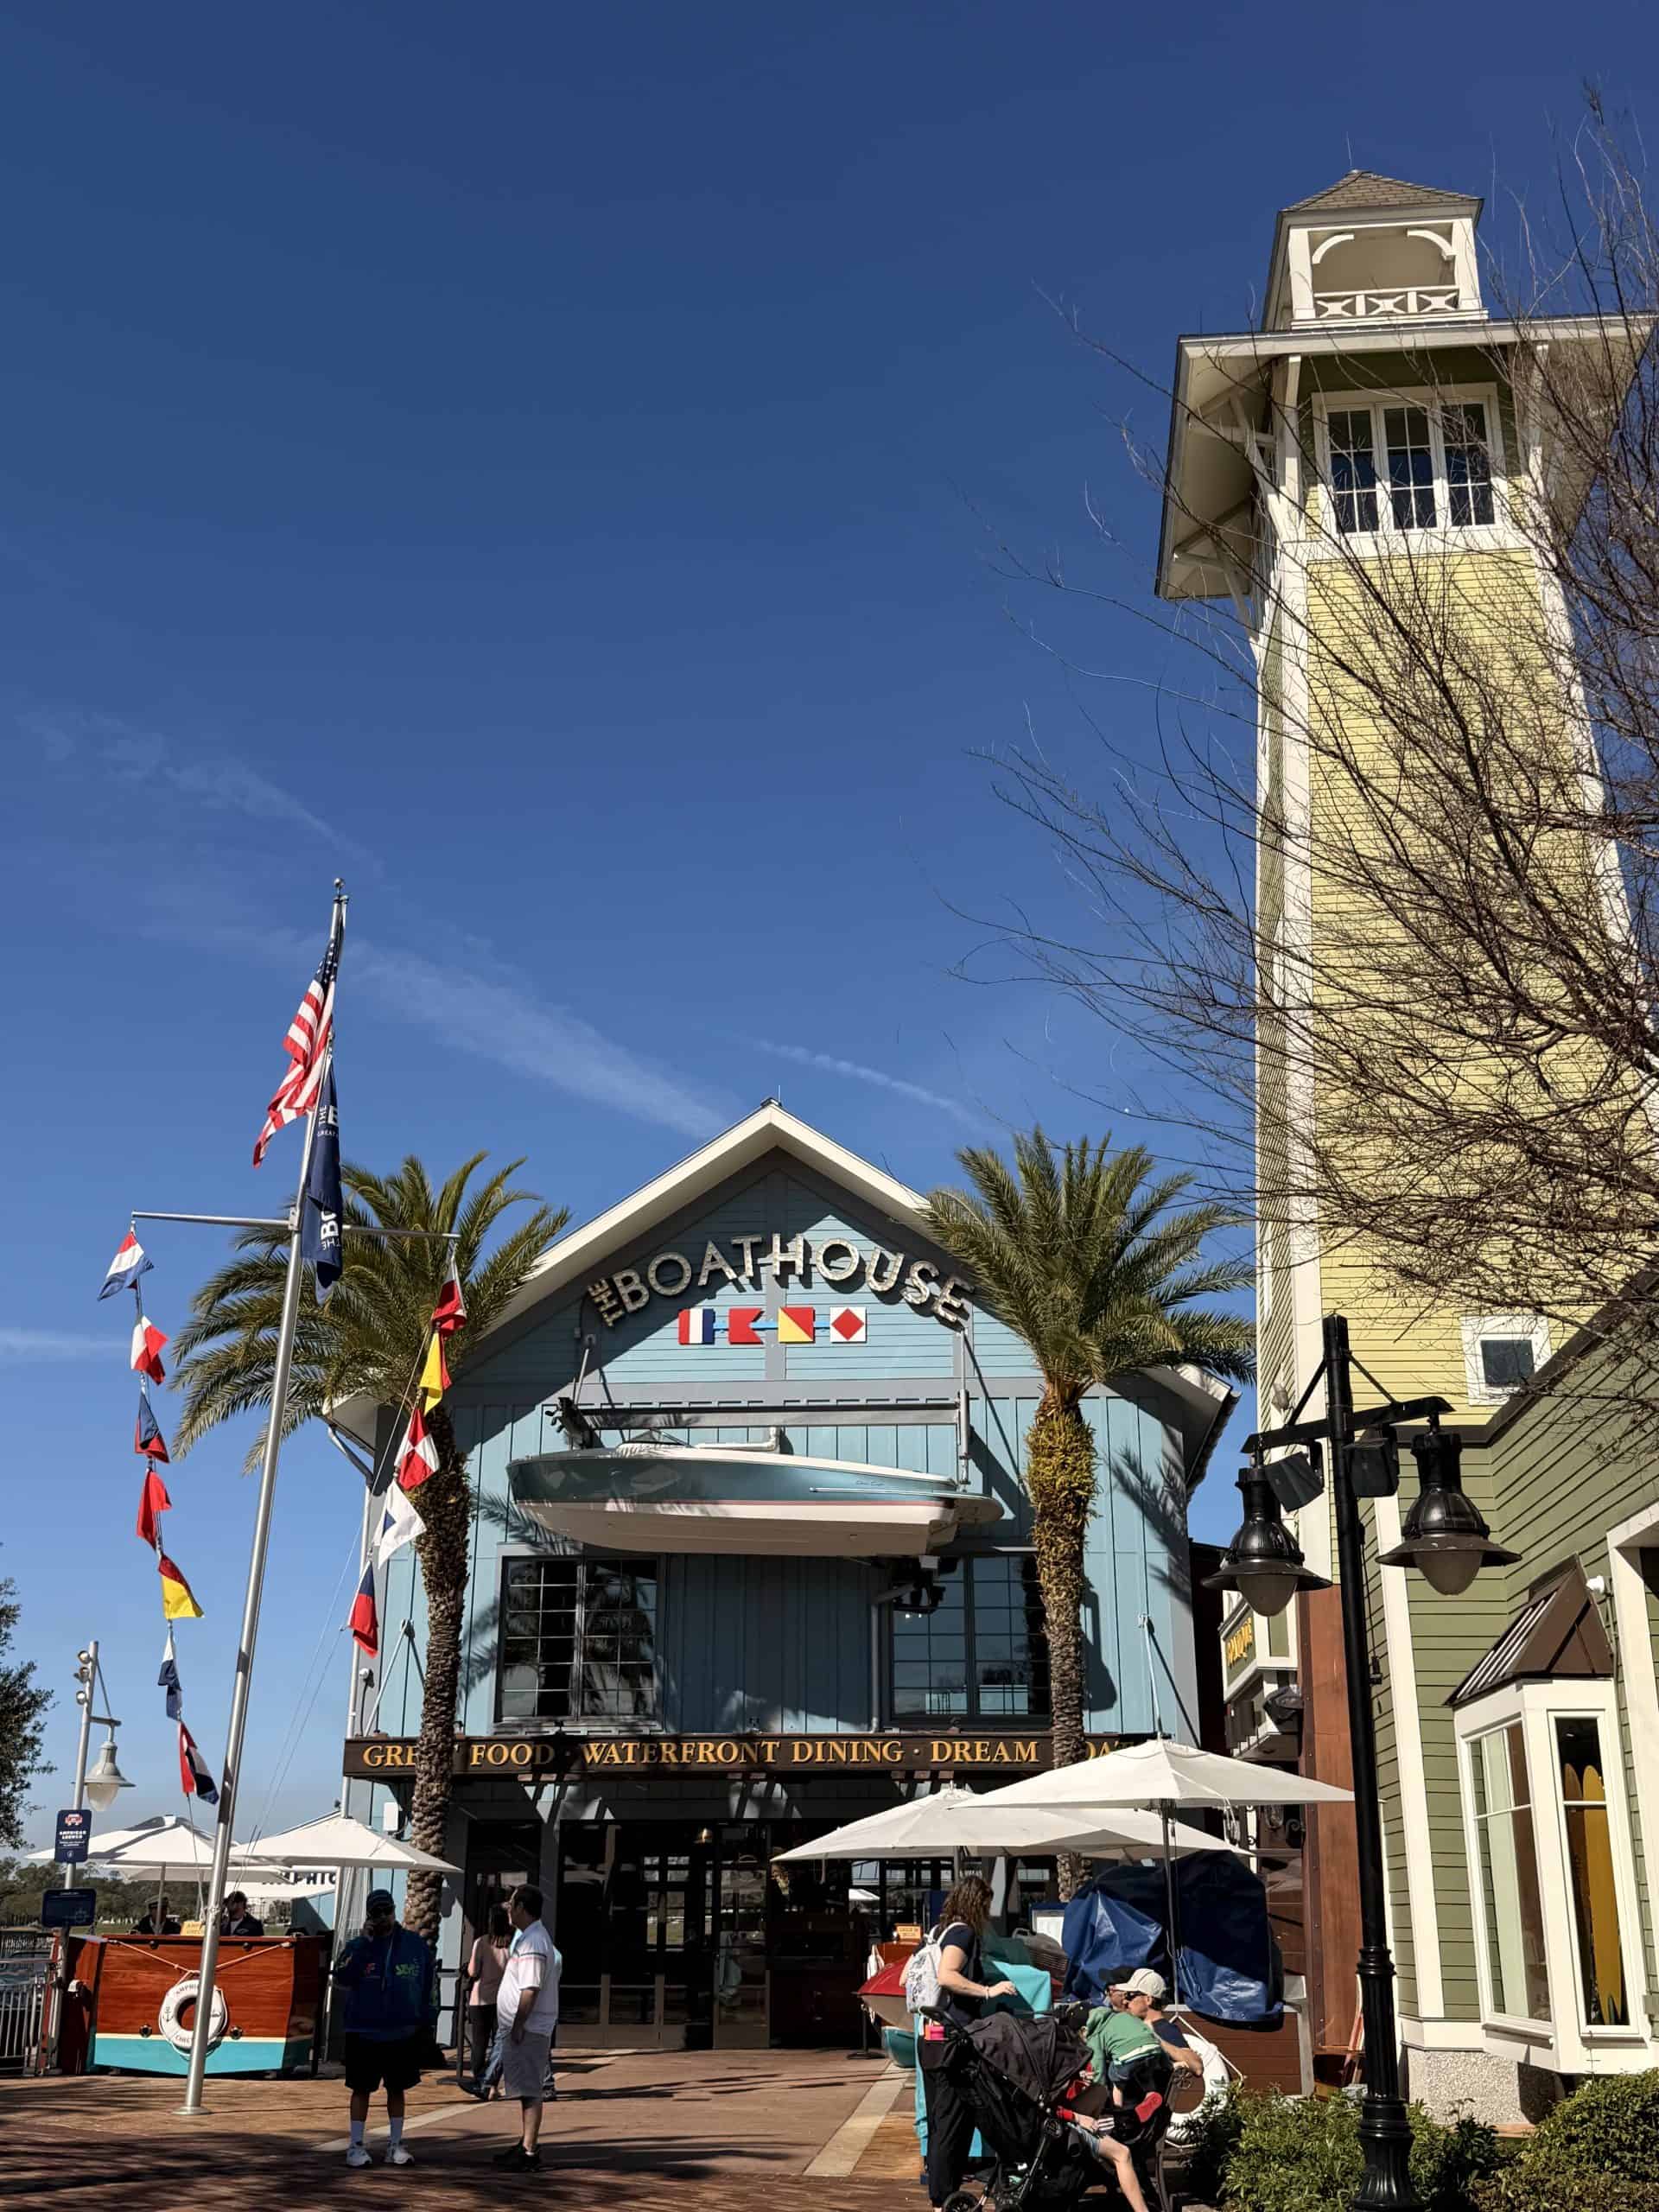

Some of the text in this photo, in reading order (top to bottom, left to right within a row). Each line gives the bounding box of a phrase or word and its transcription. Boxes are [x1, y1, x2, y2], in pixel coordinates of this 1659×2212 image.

[587, 1233, 975, 1327] THE BOATHOUSE
[363, 1741, 1039, 1767] GRE FOOD WATERFRONT DINING DREAM
